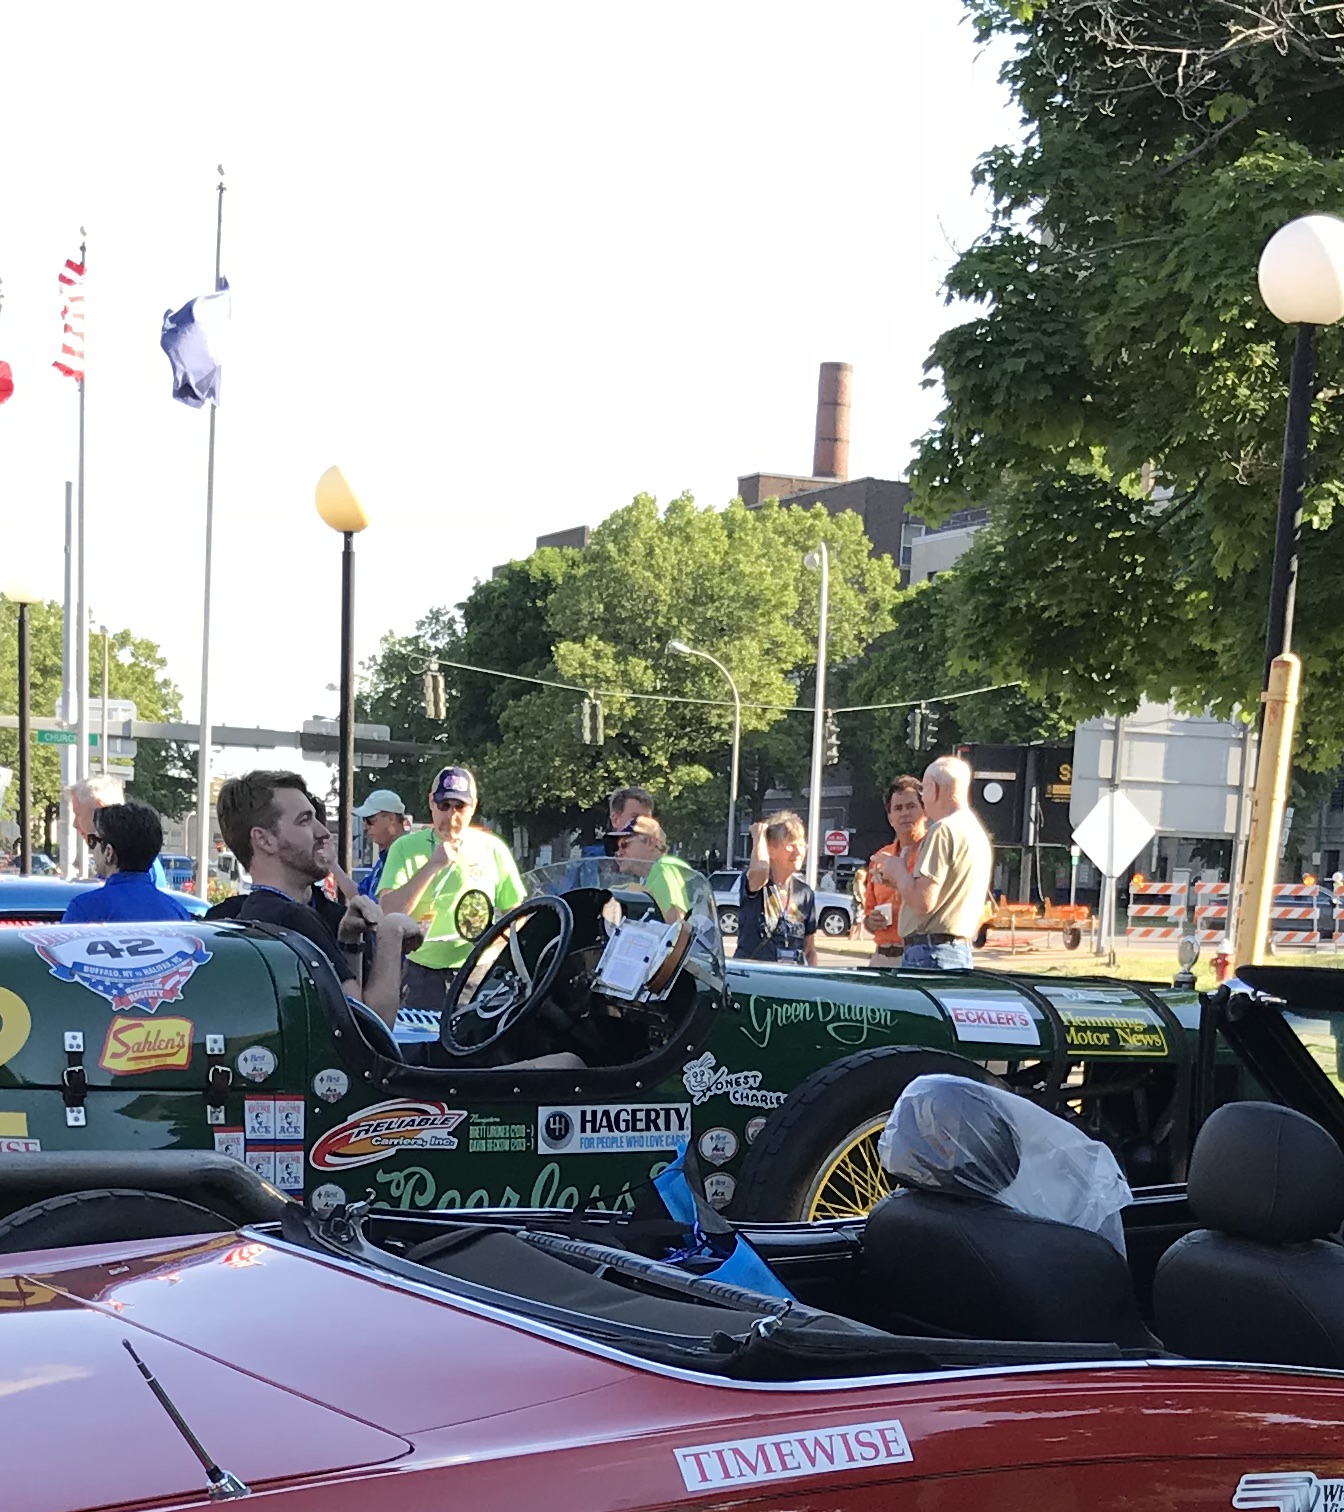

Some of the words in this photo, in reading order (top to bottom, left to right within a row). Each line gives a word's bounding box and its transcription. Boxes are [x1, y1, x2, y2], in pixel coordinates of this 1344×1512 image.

[86, 937, 164, 960] 42
[128, 988, 164, 1002] HAGERTY
[740, 994, 813, 1048] Green
[816, 1001, 899, 1045] Dragon
[953, 1008, 1030, 1027] ECKLER'S
[1058, 1011, 1148, 1032] Hemmings
[110, 1022, 185, 1059] Sahlen's
[1115, 1028, 1162, 1047] News
[732, 1090, 785, 1105] CHARLE
[249, 1125, 272, 1135] ACE
[278, 1125, 301, 1135] ACE
[354, 1114, 457, 1139] RELIABLE
[579, 1107, 689, 1134] HAGERTY
[372, 1136, 426, 1147] Carriers,
[429, 1136, 455, 1147] Inc.
[580, 1137, 595, 1149] FOR
[596, 1136, 623, 1149] PEOPLE
[623, 1135, 644, 1148] WHO
[645, 1135, 664, 1148] LOVE
[278, 1176, 301, 1185] ACE
[682, 1427, 907, 1484] TIMEWISE
